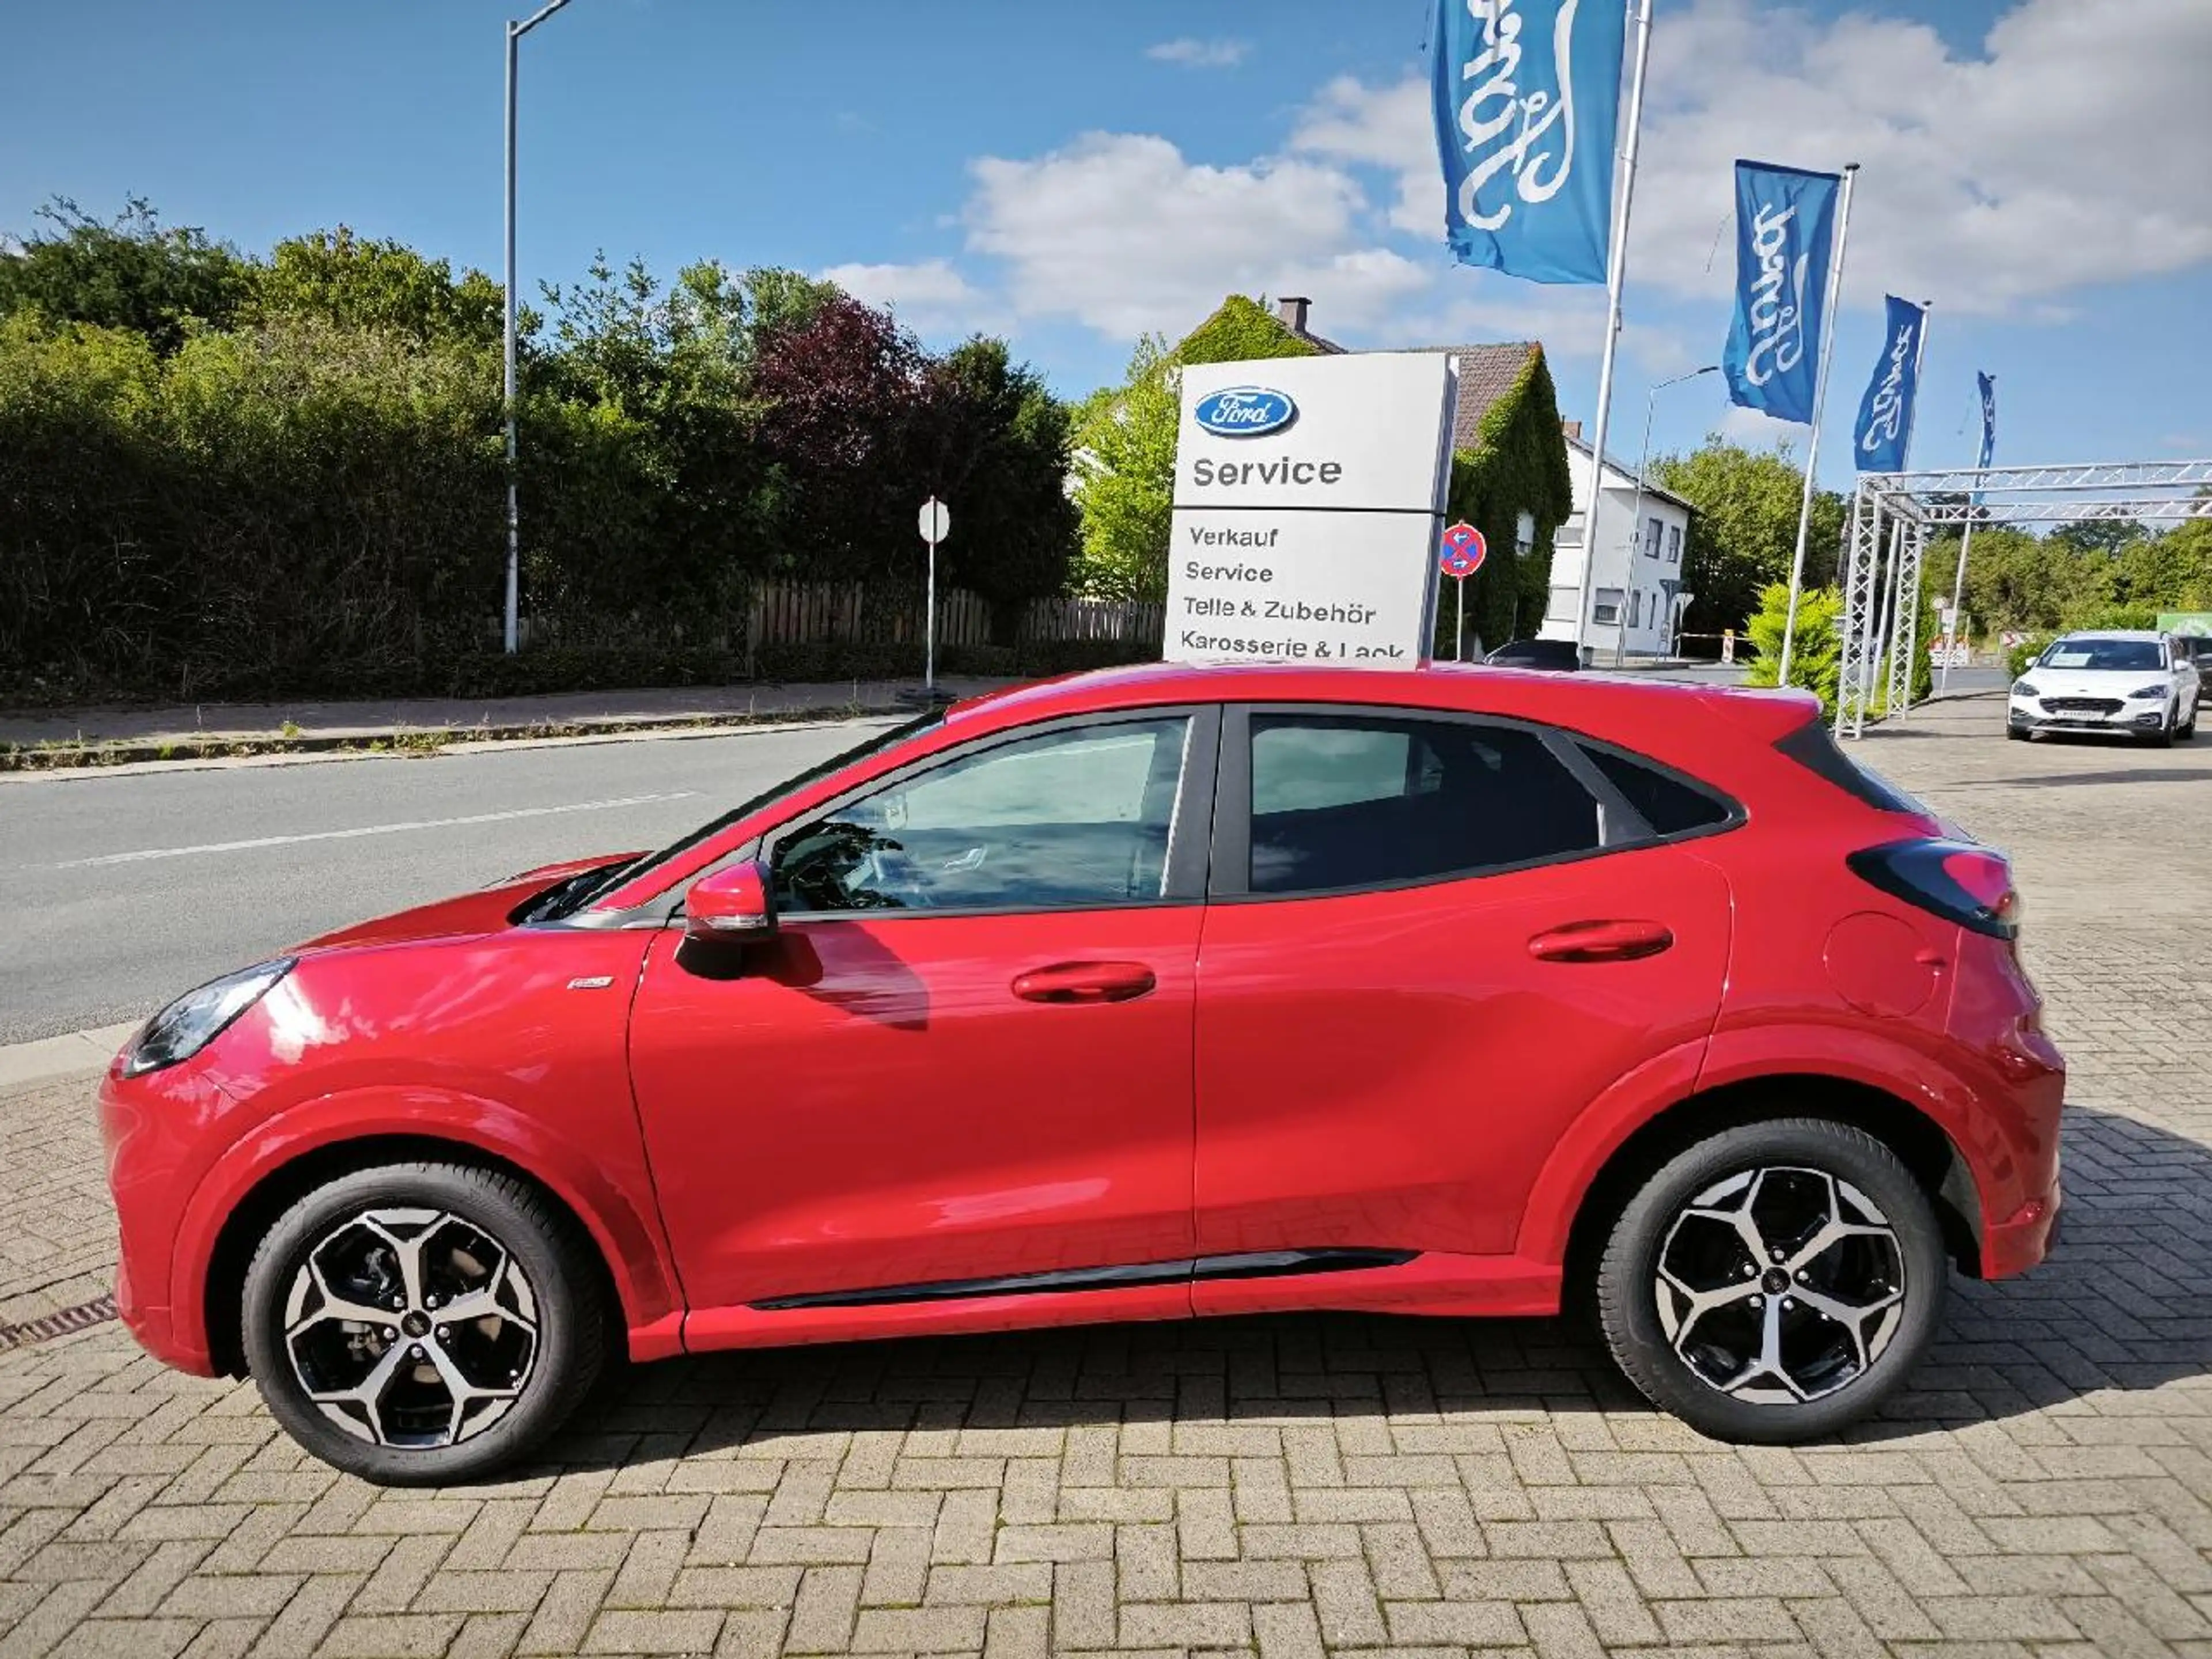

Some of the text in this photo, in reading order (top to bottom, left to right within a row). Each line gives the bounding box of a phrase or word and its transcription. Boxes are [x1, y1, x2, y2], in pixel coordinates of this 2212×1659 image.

[1210, 395, 1273, 423] Ford
[1193, 456, 1342, 487] Service
[1190, 527, 1279, 547] Verkauf
[1185, 561, 1274, 583] Service
[1240, 601, 1256, 616] &
[1264, 600, 1377, 625] Zubehör
[1181, 630, 1308, 657] Karosserie
[1315, 641, 1331, 658] &
